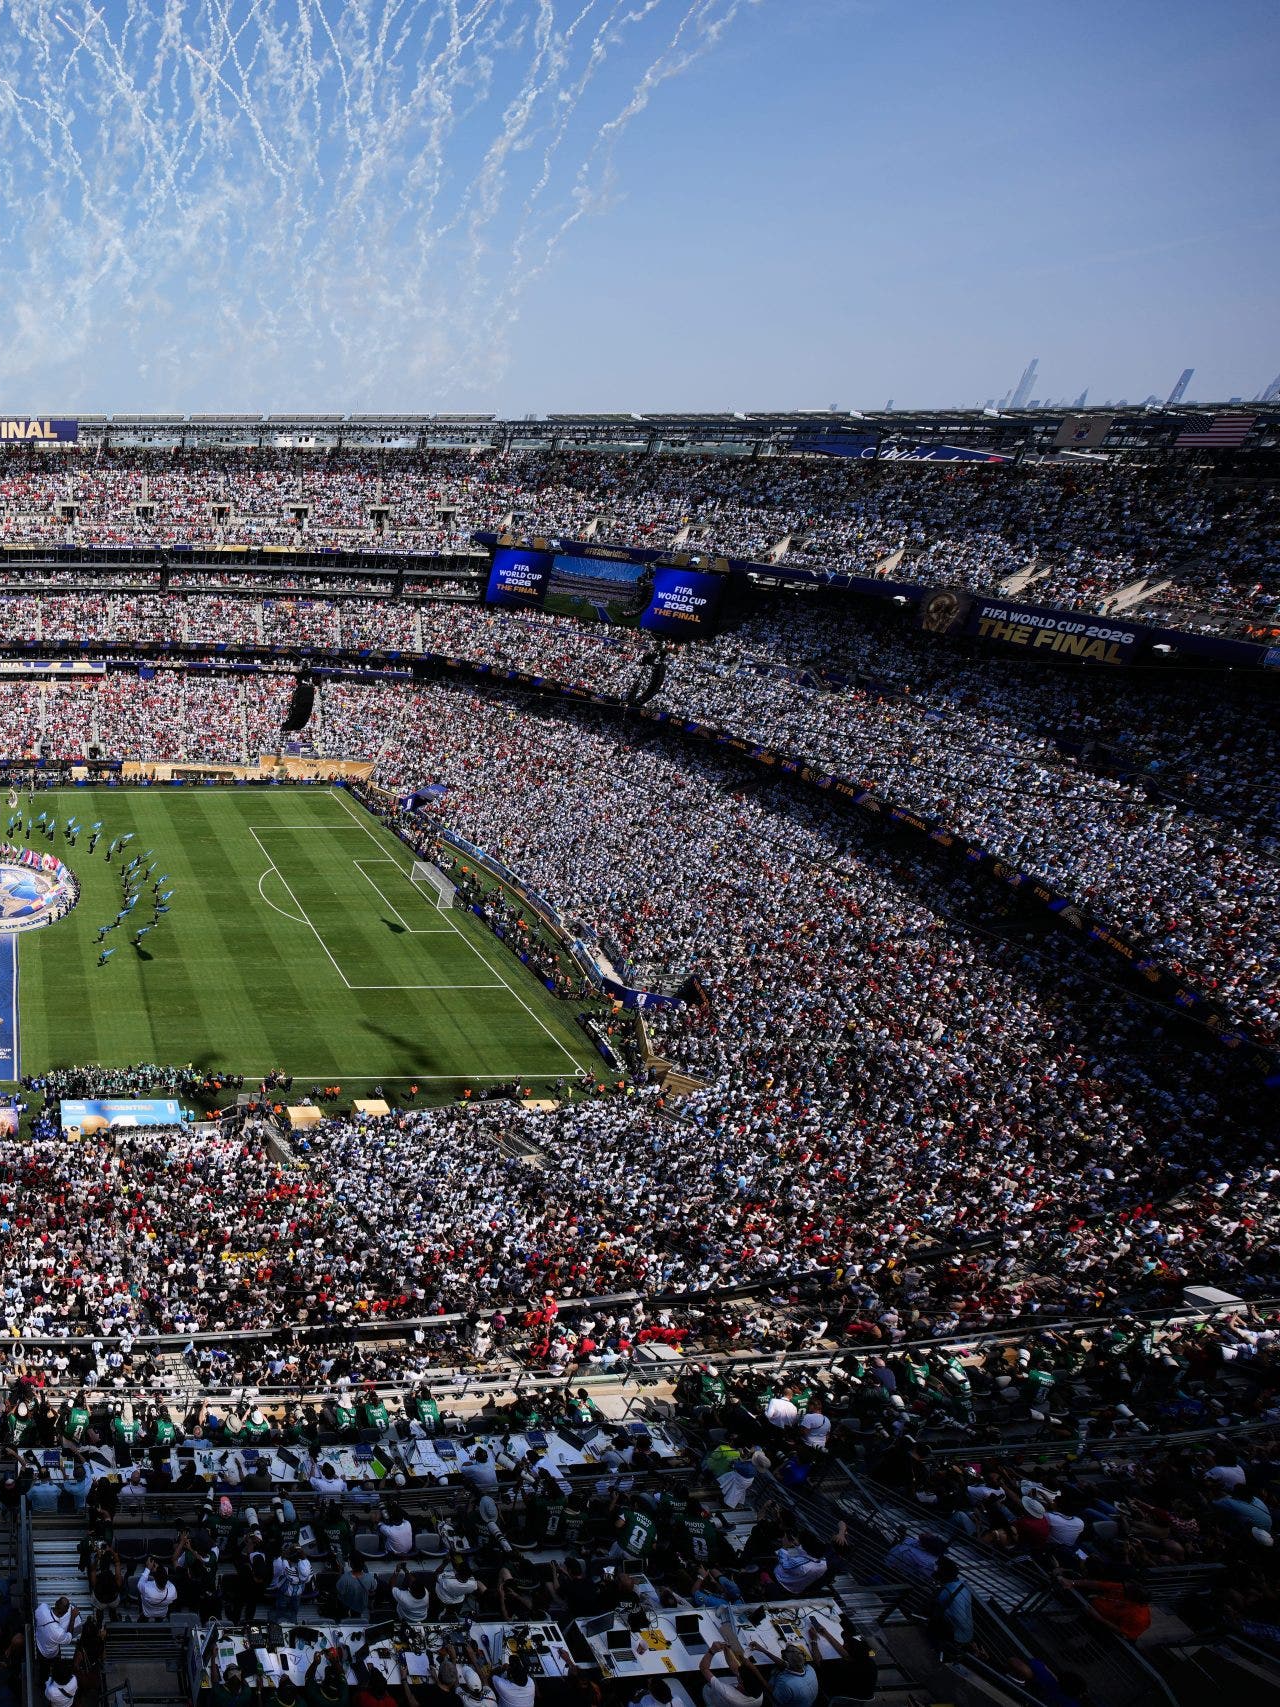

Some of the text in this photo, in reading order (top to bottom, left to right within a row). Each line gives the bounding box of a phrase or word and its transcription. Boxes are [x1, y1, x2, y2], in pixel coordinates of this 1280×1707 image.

[499, 570, 526, 578] WORLD
[514, 564, 529, 572] FIFA
[496, 583, 539, 595] THE FINAL
[505, 578, 531, 586] 2026
[674, 586, 693, 595] FIFA
[658, 592, 707, 606] WORLD CUP
[663, 601, 694, 612] 2026
[653, 608, 701, 623] THE FINAL
[981, 607, 1136, 645] FIFA WORLD CUP 2026
[976, 618, 1123, 665] THE FINAL
[835, 783, 855, 797] FIFA
[904, 815, 929, 831] FINAL
[1033, 885, 1052, 902] FIFA
[1107, 936, 1136, 959] FINAL
